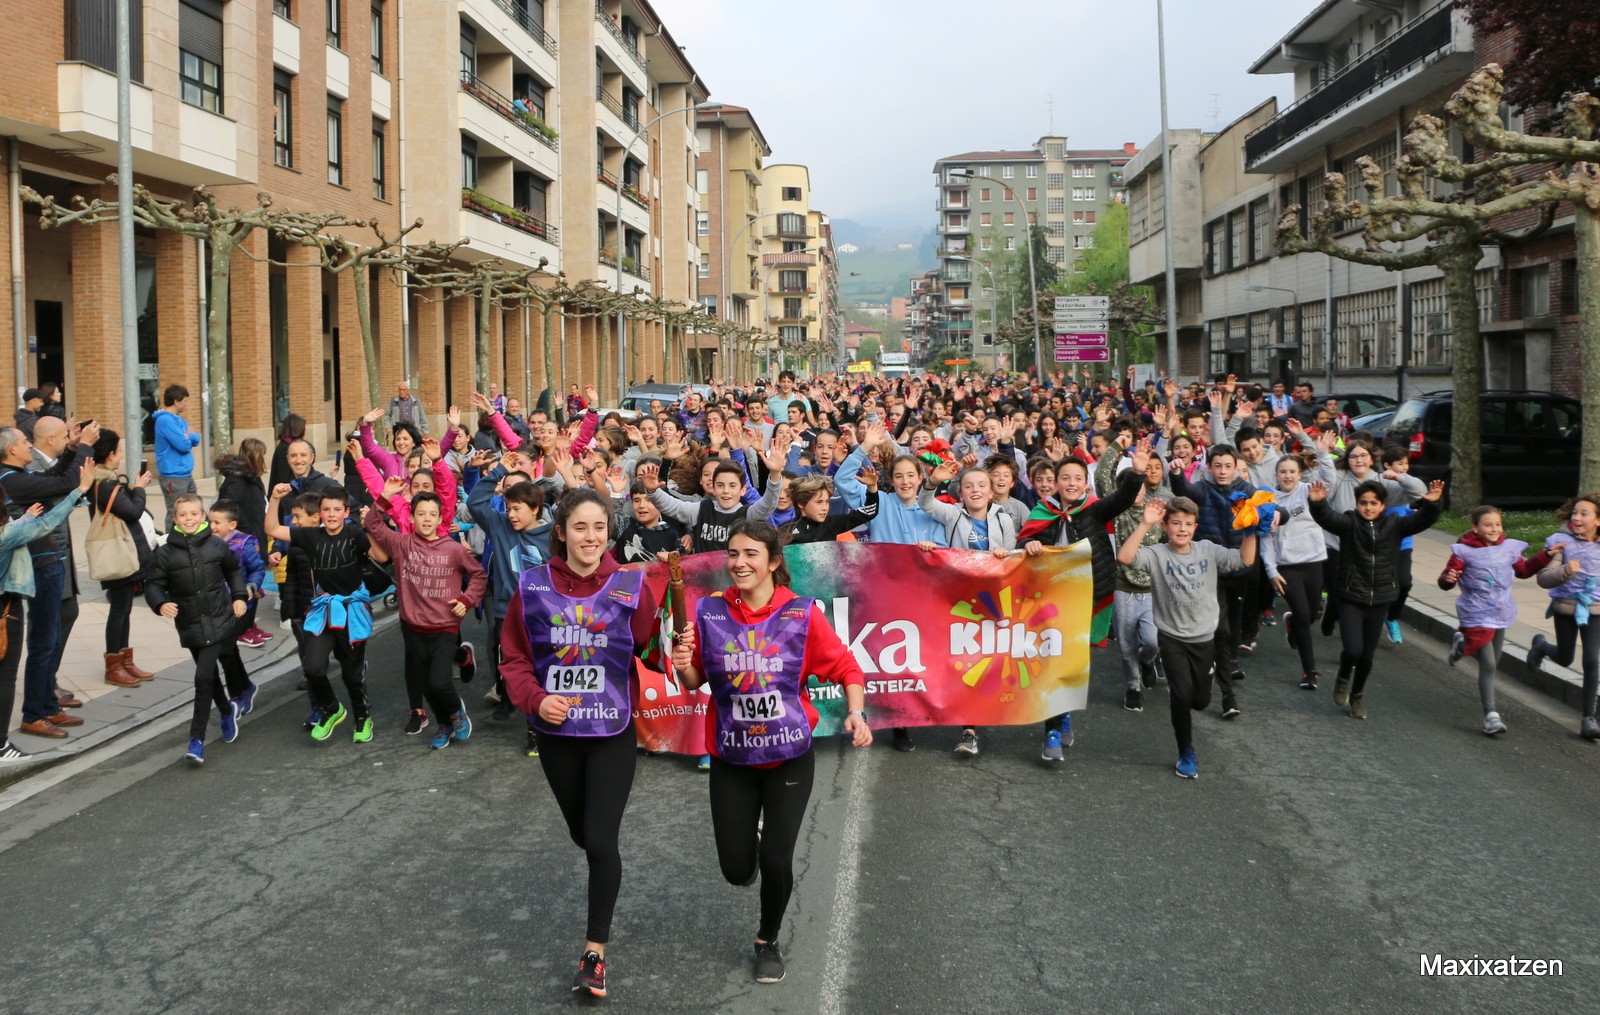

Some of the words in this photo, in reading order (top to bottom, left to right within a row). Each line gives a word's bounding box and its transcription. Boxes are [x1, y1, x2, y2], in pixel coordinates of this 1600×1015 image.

[427, 556, 435, 564] IS
[436, 555, 450, 565] THE
[1166, 558, 1209, 576] HIGH
[420, 565, 455, 576] EXCELLENT
[435, 578, 448, 588] THE
[550, 624, 608, 648] Klika
[950, 619, 1063, 659] Klika
[723, 650, 784, 673] Klika
[553, 667, 599, 691] 1942
[1000, 690, 1017, 702] aek
[567, 702, 619, 719] orrika
[738, 694, 780, 719] 1942
[743, 726, 804, 748] korrika
[748, 722, 768, 735] aek
